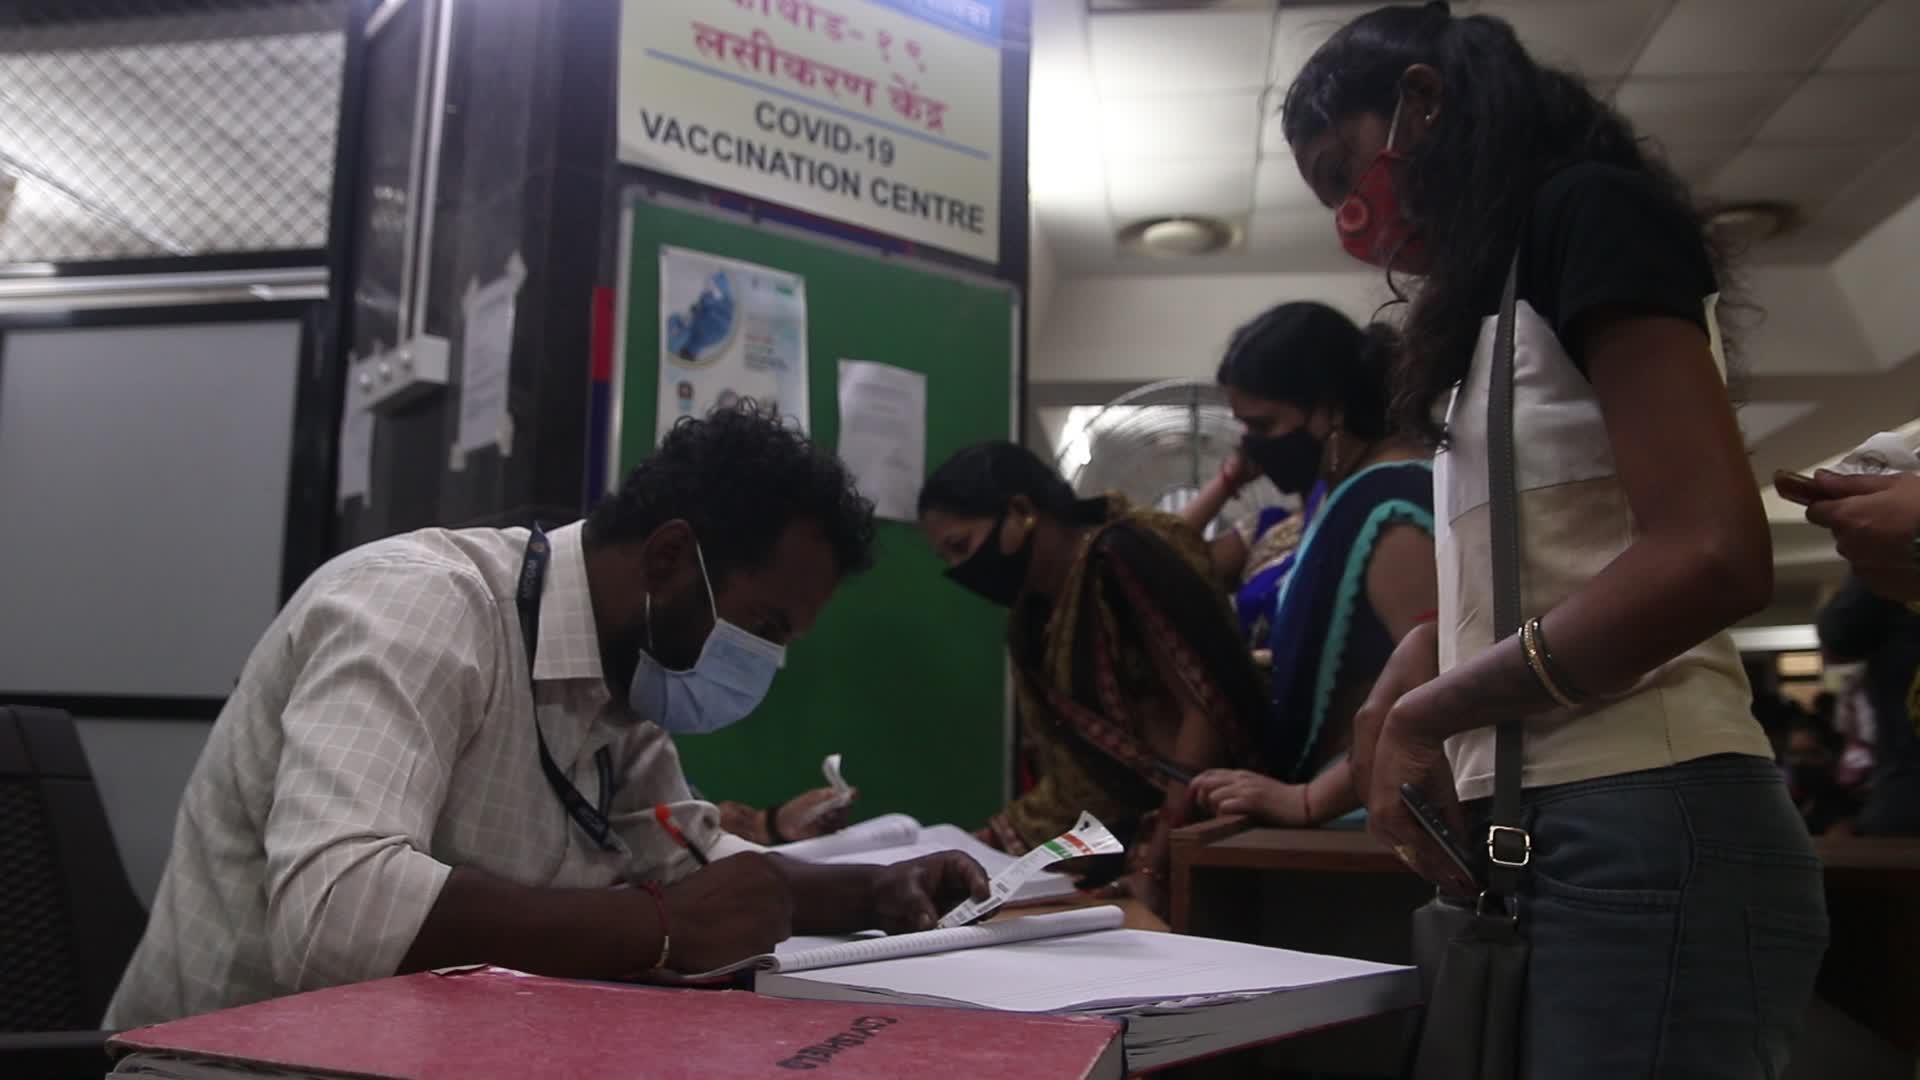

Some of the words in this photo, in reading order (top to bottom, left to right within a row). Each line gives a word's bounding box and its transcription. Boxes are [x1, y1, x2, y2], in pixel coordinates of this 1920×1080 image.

[690, 20, 879, 108] लसीकरण
[885, 72, 948, 133] केंद्र
[640, 108, 861, 200] VACCINATION
[869, 177, 985, 235] CENTRE
[755, 101, 896, 167] COVID-19
